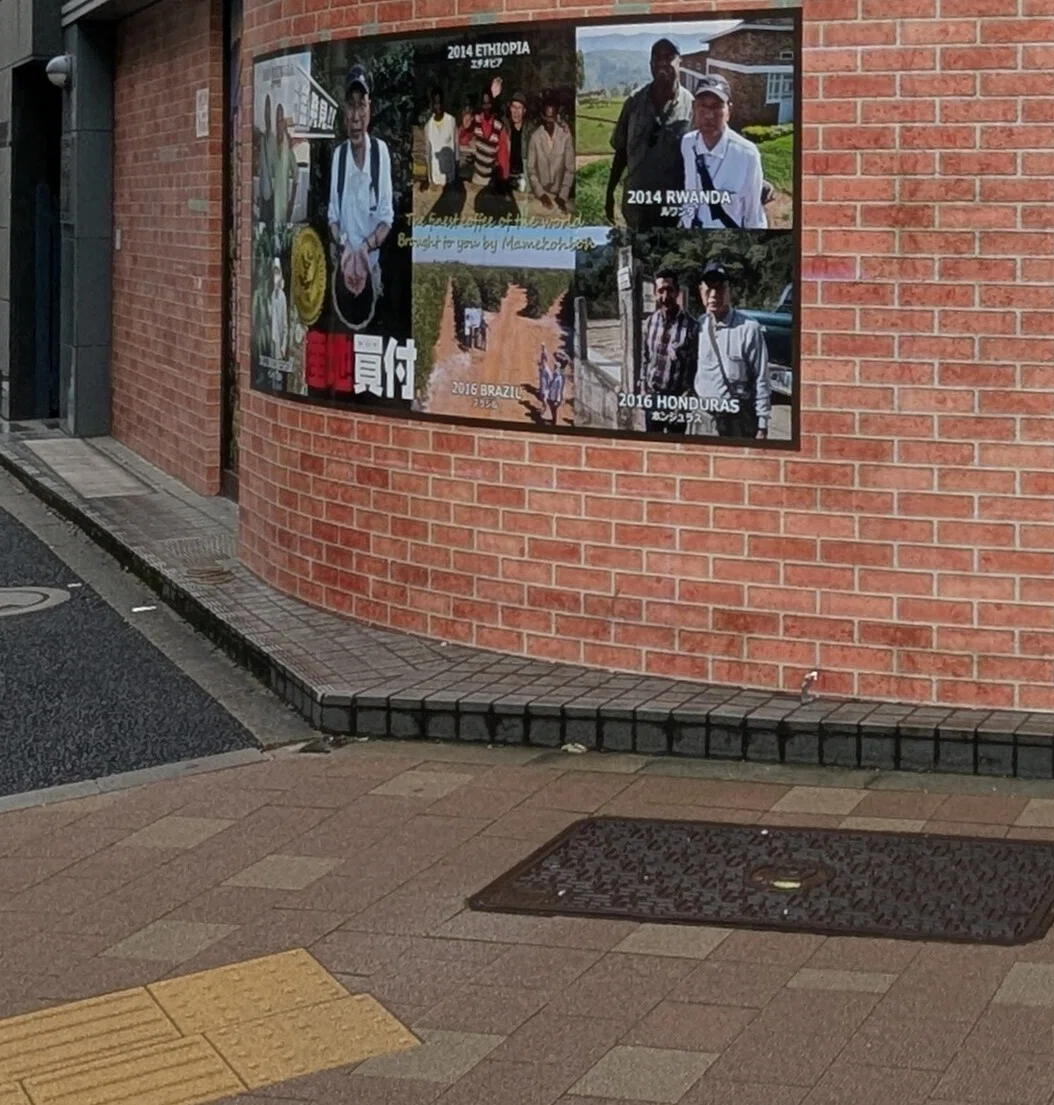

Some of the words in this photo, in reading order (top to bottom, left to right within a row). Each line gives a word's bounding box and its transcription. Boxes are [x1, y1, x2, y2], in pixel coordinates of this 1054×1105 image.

[447, 44, 473, 59] 2014
[475, 40, 531, 57] ETHIOPIA
[627, 189, 662, 205] 2014
[666, 189, 732, 205] RWANDA
[451, 380, 478, 396] 2016
[480, 383, 522, 400] BRAZIL
[618, 392, 653, 409] 2016
[656, 394, 740, 414] HONDURAS
